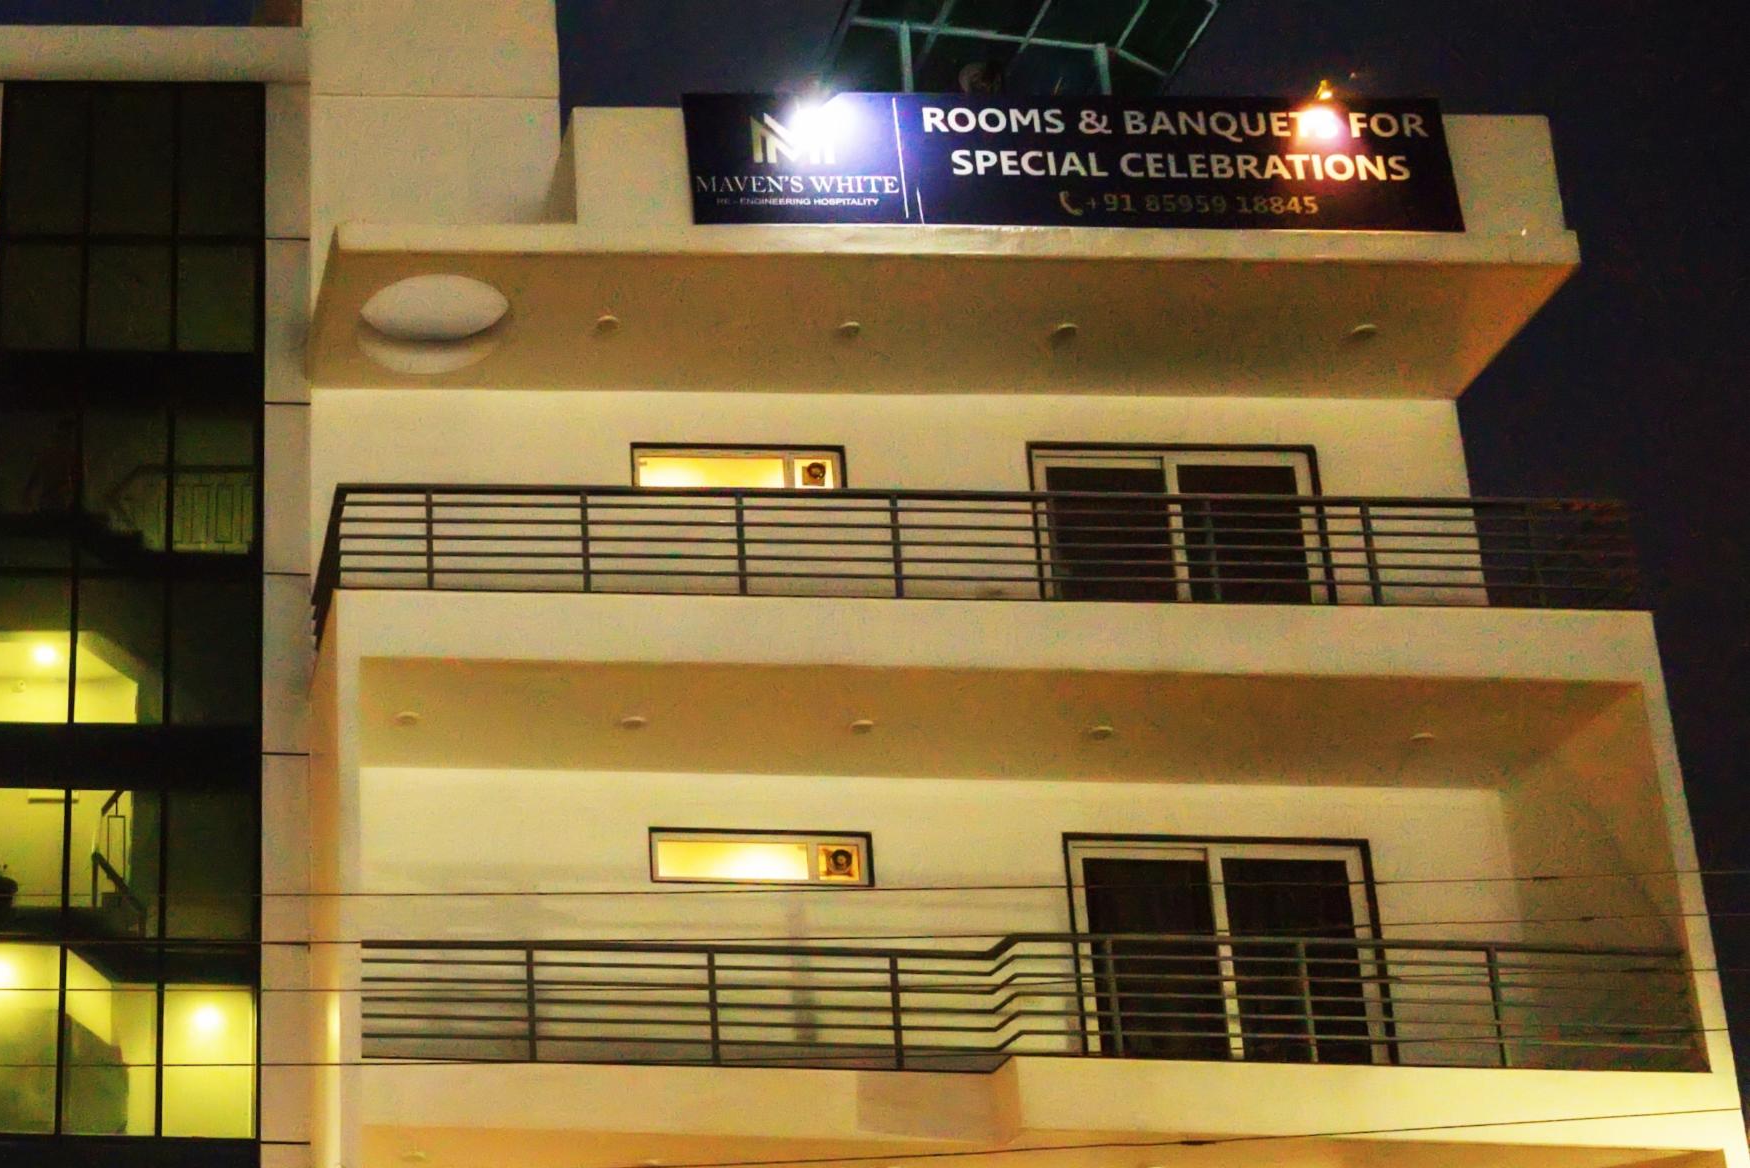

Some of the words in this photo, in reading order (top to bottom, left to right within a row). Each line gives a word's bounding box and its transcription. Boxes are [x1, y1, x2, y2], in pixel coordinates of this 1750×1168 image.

[922, 107, 1065, 134] ROOMS
[1078, 110, 1112, 135] &
[1349, 112, 1429, 138] FOR
[952, 150, 1108, 177] SPECIAL
[1120, 153, 1411, 181] CELEBRATIONS
[696, 175, 804, 193] MAVEN'S
[809, 175, 900, 194] WHITE
[740, 198, 811, 206] ENGINEERING
[814, 198, 880, 206] HOSPITALITY
